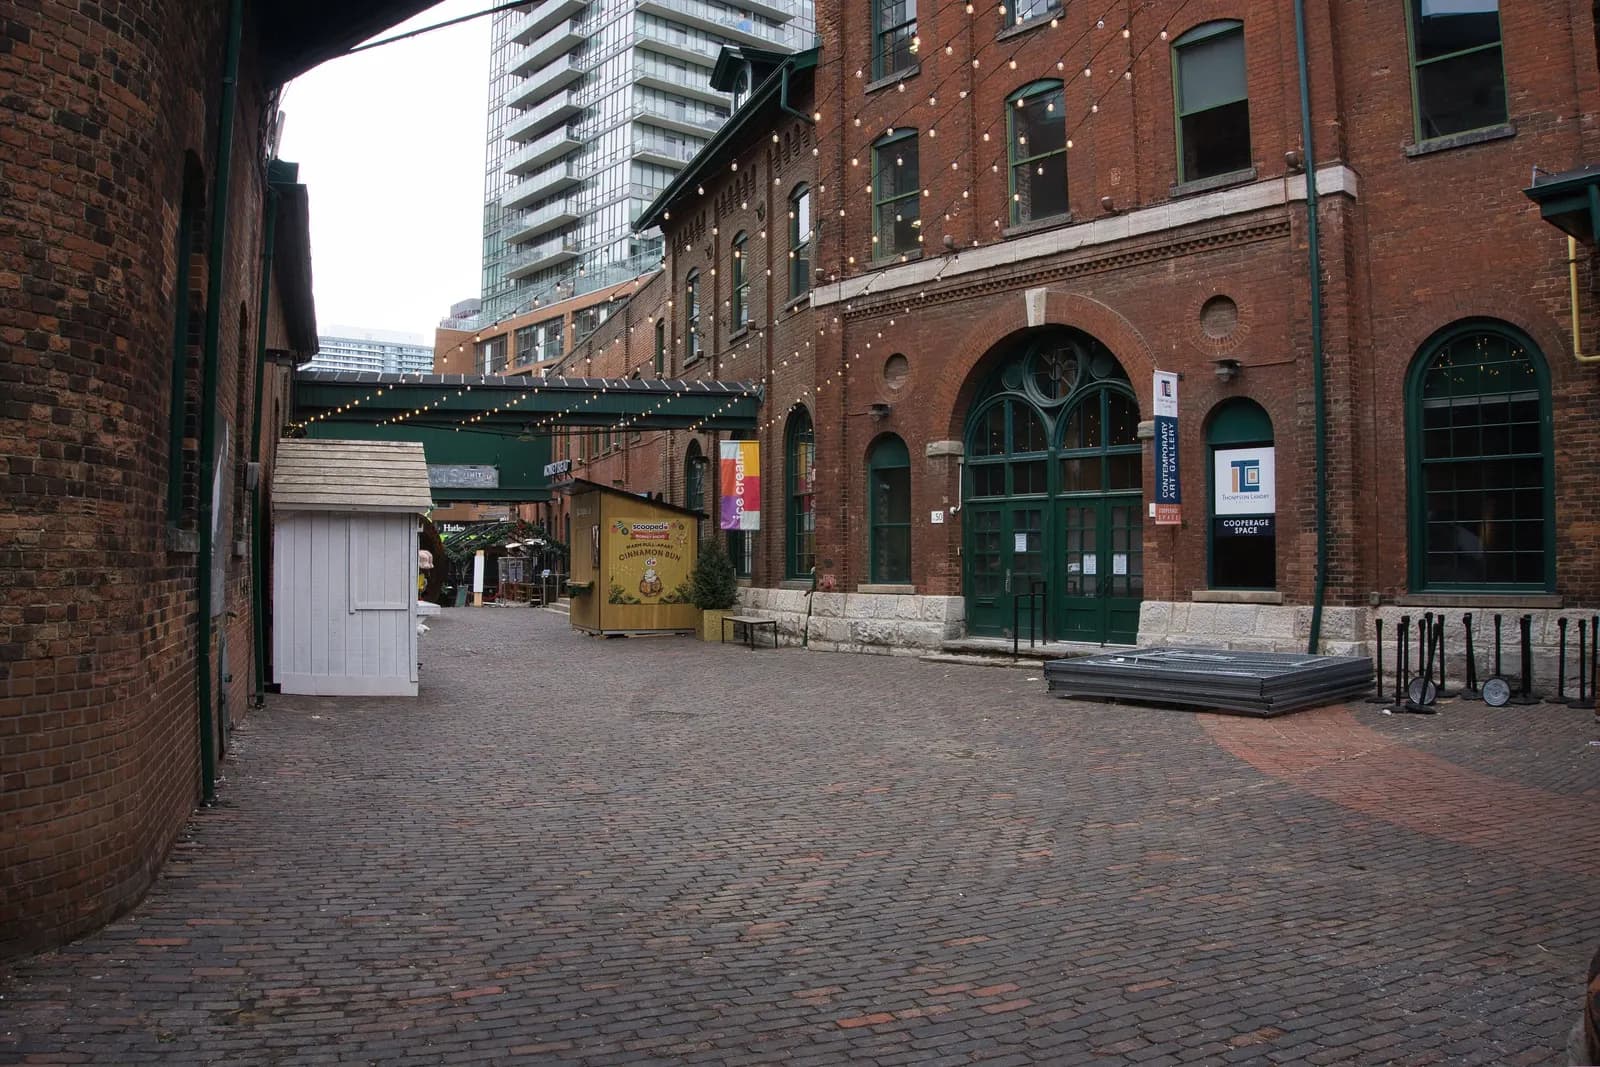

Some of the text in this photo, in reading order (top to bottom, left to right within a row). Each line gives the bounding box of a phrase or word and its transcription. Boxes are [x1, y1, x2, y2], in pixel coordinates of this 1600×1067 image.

[1168, 422, 1176, 472] GALLERY
[1161, 422, 1169, 498] CONTEMPORARY
[732, 450, 745, 520] ice cream
[443, 523, 466, 532] Hatley
[1223, 519, 1269, 527] COOPERAGE
[1234, 526, 1258, 535] SPACE
[619, 549, 681, 562] CINNAMON BUN
